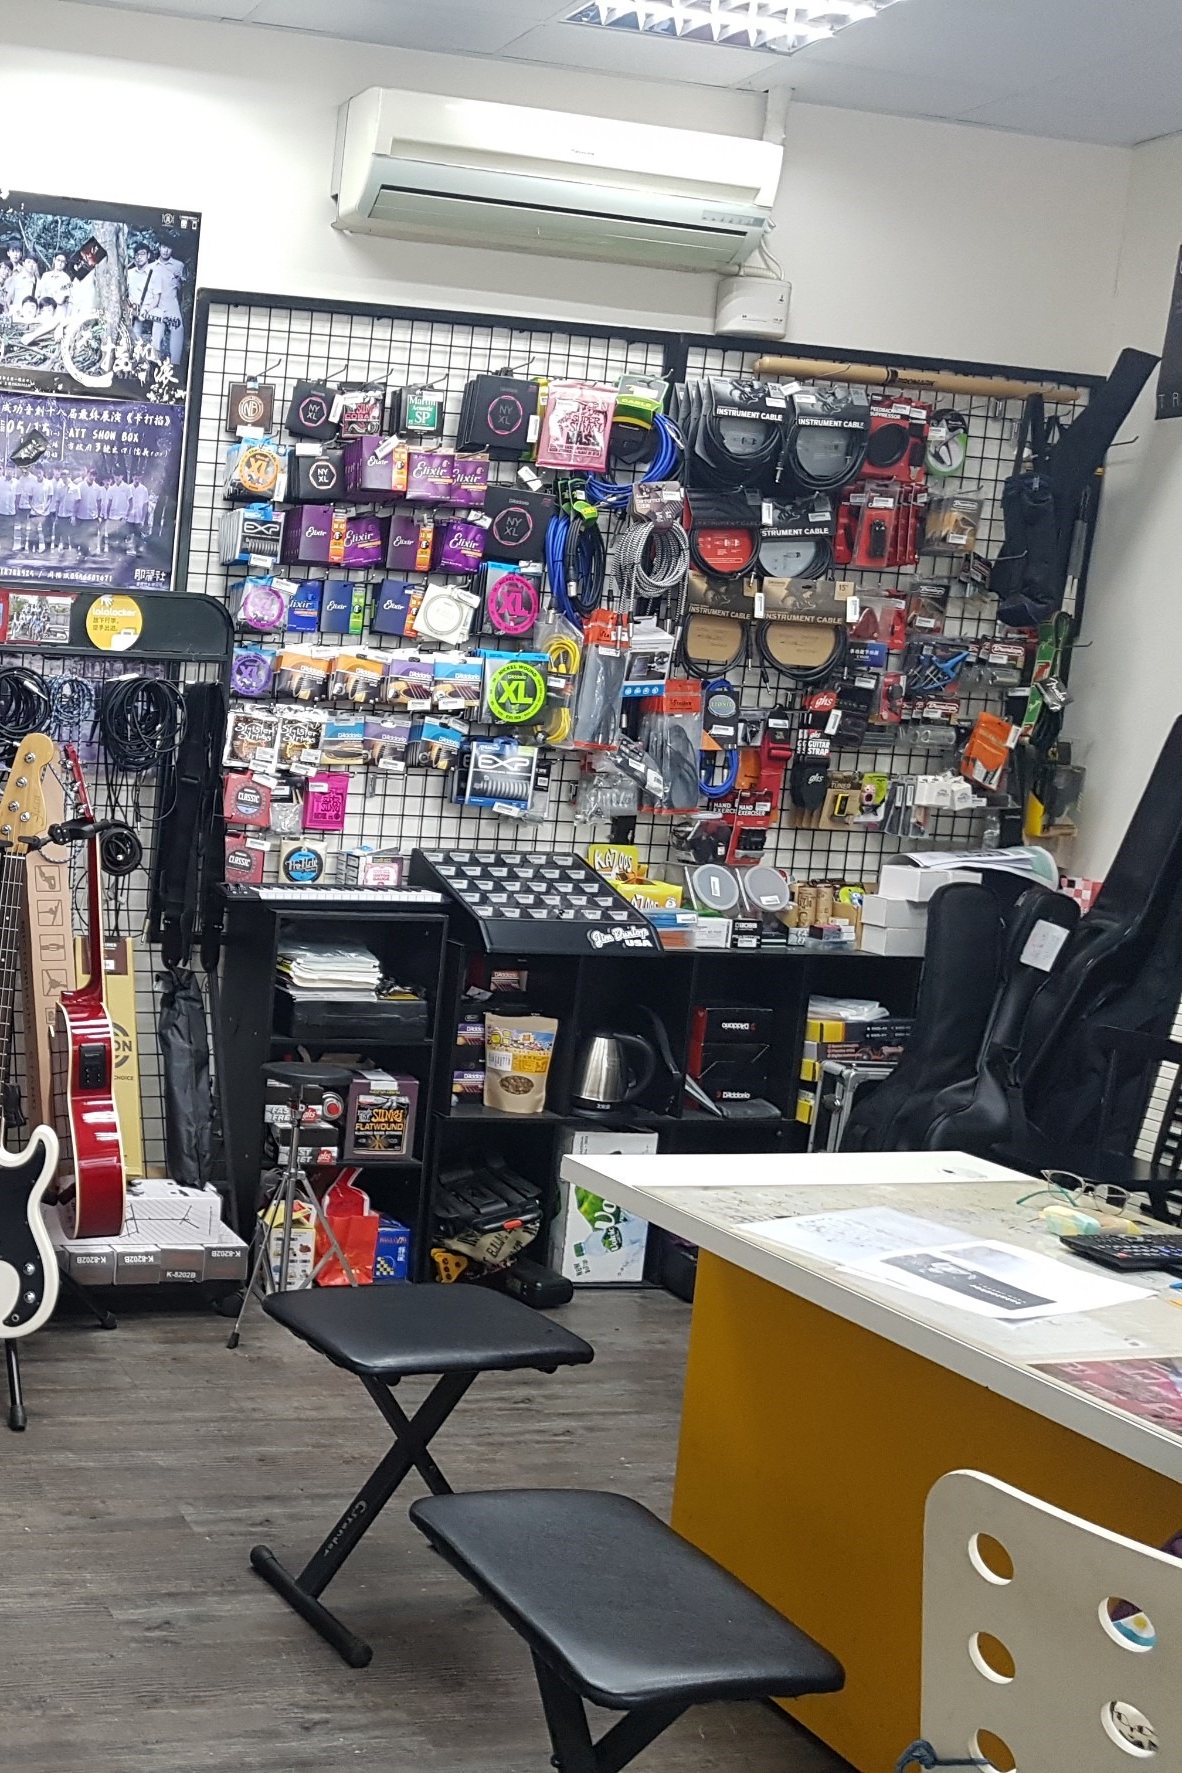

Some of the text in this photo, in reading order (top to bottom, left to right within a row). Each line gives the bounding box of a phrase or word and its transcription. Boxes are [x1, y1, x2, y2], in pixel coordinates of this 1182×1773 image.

[309, 404, 320, 412] NY
[621, 398, 652, 407] CABLE
[499, 405, 513, 414] NY
[716, 408, 783, 422] INSTRUMENT CABLE
[306, 412, 317, 420] XL
[415, 411, 431, 423] SP
[498, 415, 511, 425] XL
[798, 418, 864, 429] INSTRUMENT CABLE
[68, 428, 138, 442] ATT SHOW BOX
[367, 455, 388, 466] Elixir
[249, 457, 268, 478] XL
[413, 461, 448, 478] Elixir
[506, 517, 522, 526] NY
[244, 521, 279, 534] EXP
[305, 526, 327, 538] Elixir
[504, 526, 518, 537] XL
[761, 527, 829, 537] STRUMENT CABLE
[344, 530, 374, 547] Elixir
[393, 536, 414, 546] Elixir
[449, 532, 478, 549] Elixir
[289, 600, 312, 608] lixir
[327, 600, 347, 611] Elixir
[383, 599, 405, 610] Elixir
[498, 592, 529, 616] XL
[689, 606, 751, 620] INSTRUMENT CABLE
[817, 616, 842, 624] CABLE
[239, 665, 262, 679] XL
[499, 664, 538, 678] NICKEL WOUND
[498, 680, 534, 705] XL
[815, 696, 833, 708] ghs
[478, 755, 530, 770] EXP
[808, 773, 824, 784] ghs
[238, 793, 260, 803] CLASSIC
[228, 854, 251, 866] CLASSIC
[594, 849, 633, 876] KAZOOS
[591, 925, 649, 948] Jim Dunlop
[624, 939, 653, 947] USA
[302, 1111, 315, 1120] ghs
[371, 1109, 403, 1122] SLINKY
[355, 1123, 404, 1131] FLATWOUND
[318, 1151, 331, 1161] ghs
[124, 1255, 154, 1263] K-8202B
[211, 1250, 241, 1258] K-8202B
[76, 1256, 106, 1264] K-8202B
[166, 1271, 196, 1279] K-8202B
